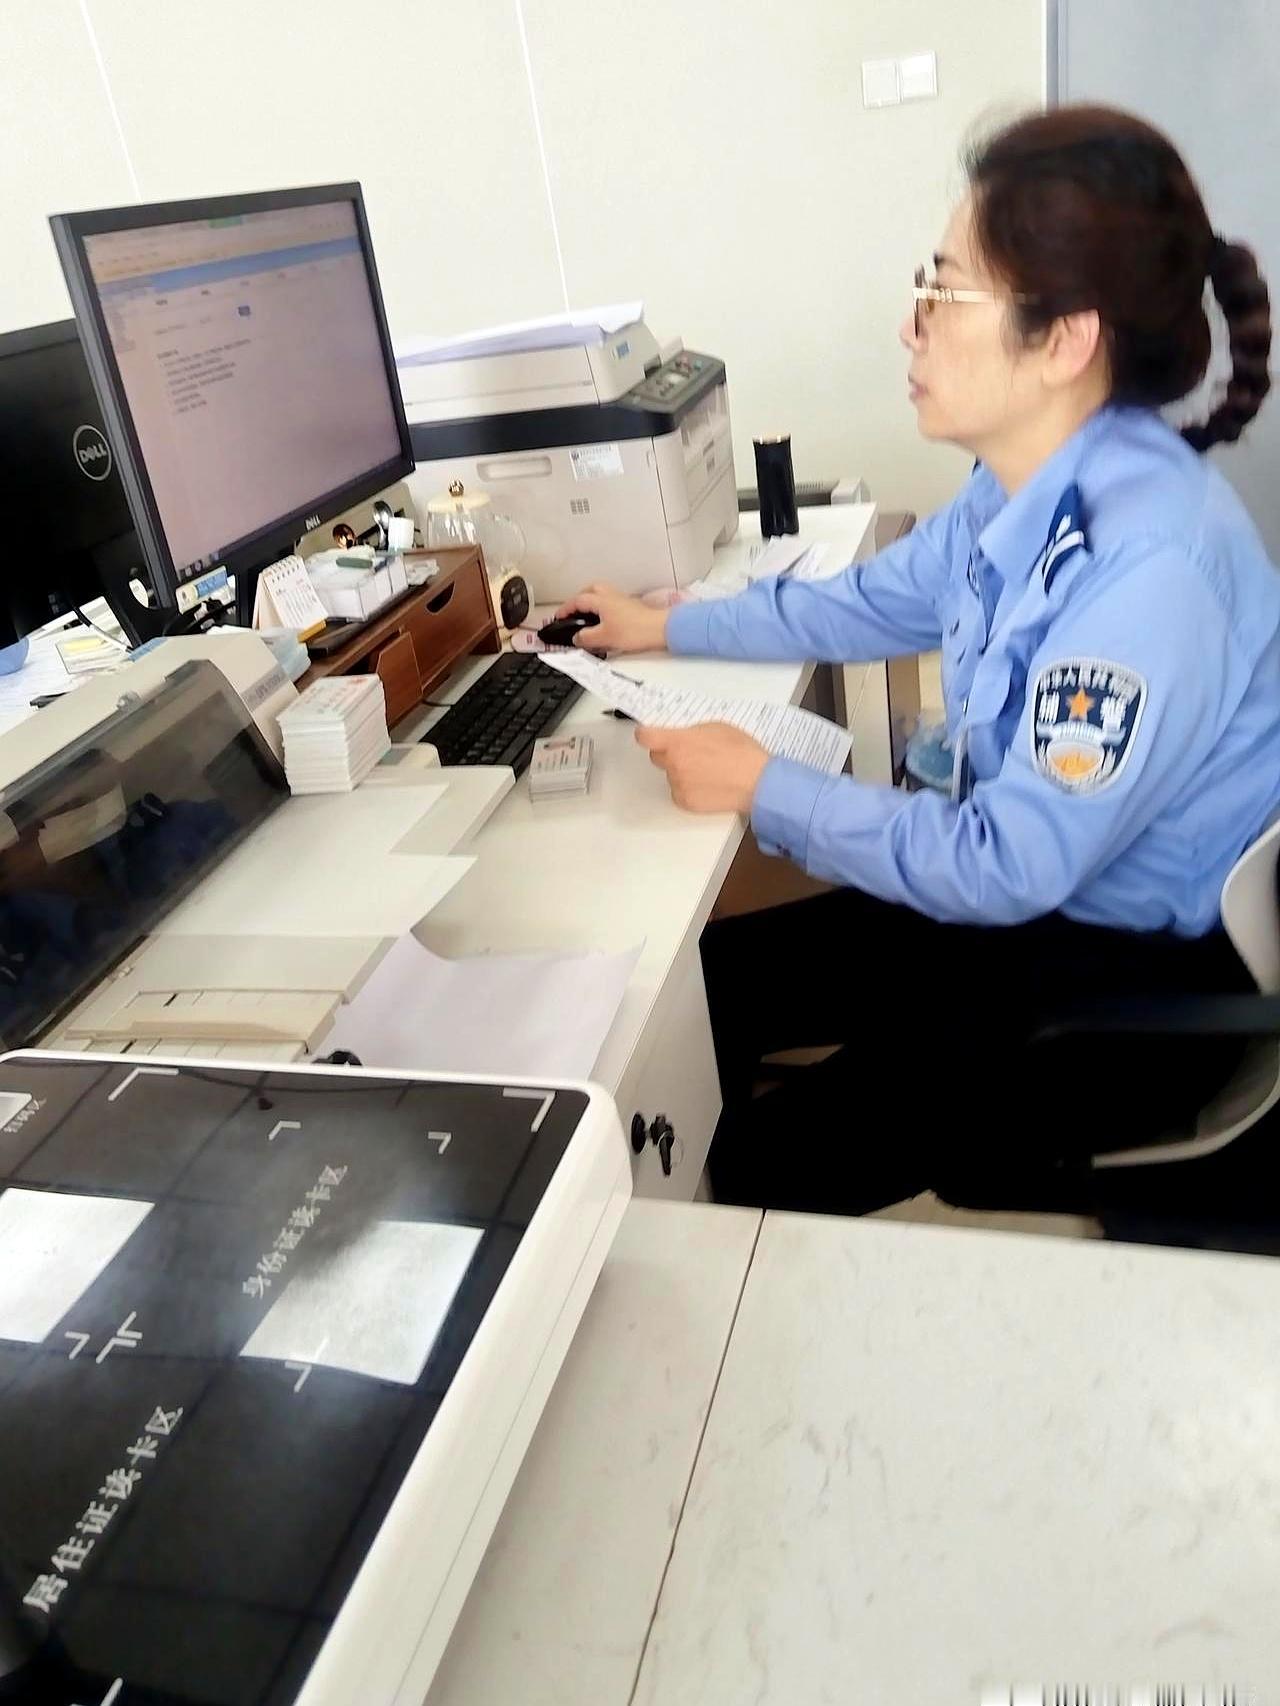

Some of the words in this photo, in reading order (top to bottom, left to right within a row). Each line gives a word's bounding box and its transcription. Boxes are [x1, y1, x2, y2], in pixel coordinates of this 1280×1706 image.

[79, 444, 107, 463] DELL
[242, 1165, 348, 1299] 身份证读卡区
[23, 1405, 183, 1613] 居住证读卡区
